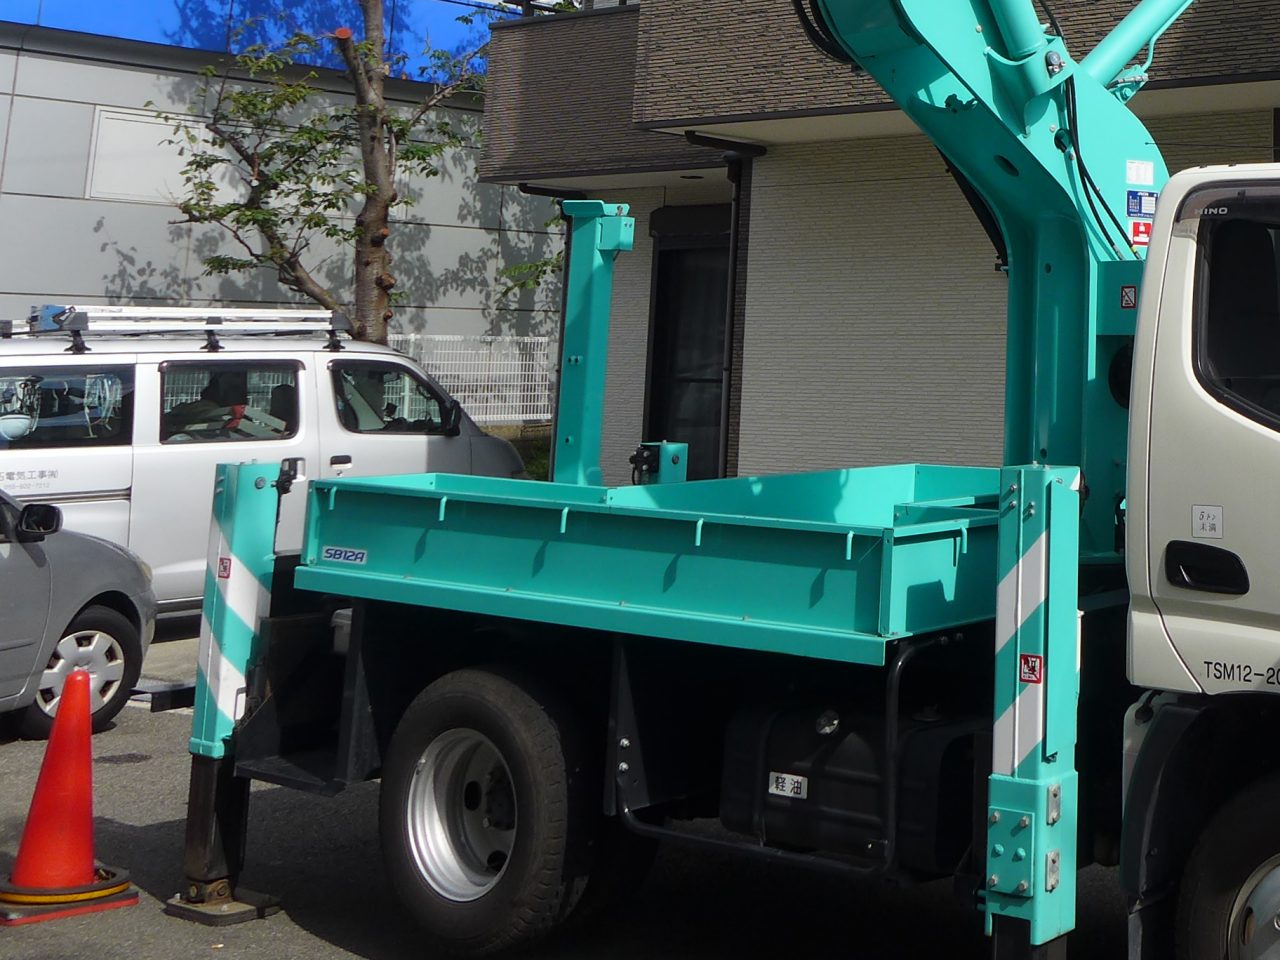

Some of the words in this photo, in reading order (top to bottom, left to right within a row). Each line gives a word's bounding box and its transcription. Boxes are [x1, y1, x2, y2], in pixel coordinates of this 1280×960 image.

[1194, 207, 1228, 215] HINO
[324, 548, 366, 562] SB12A
[775, 775, 802, 795] 軽油
